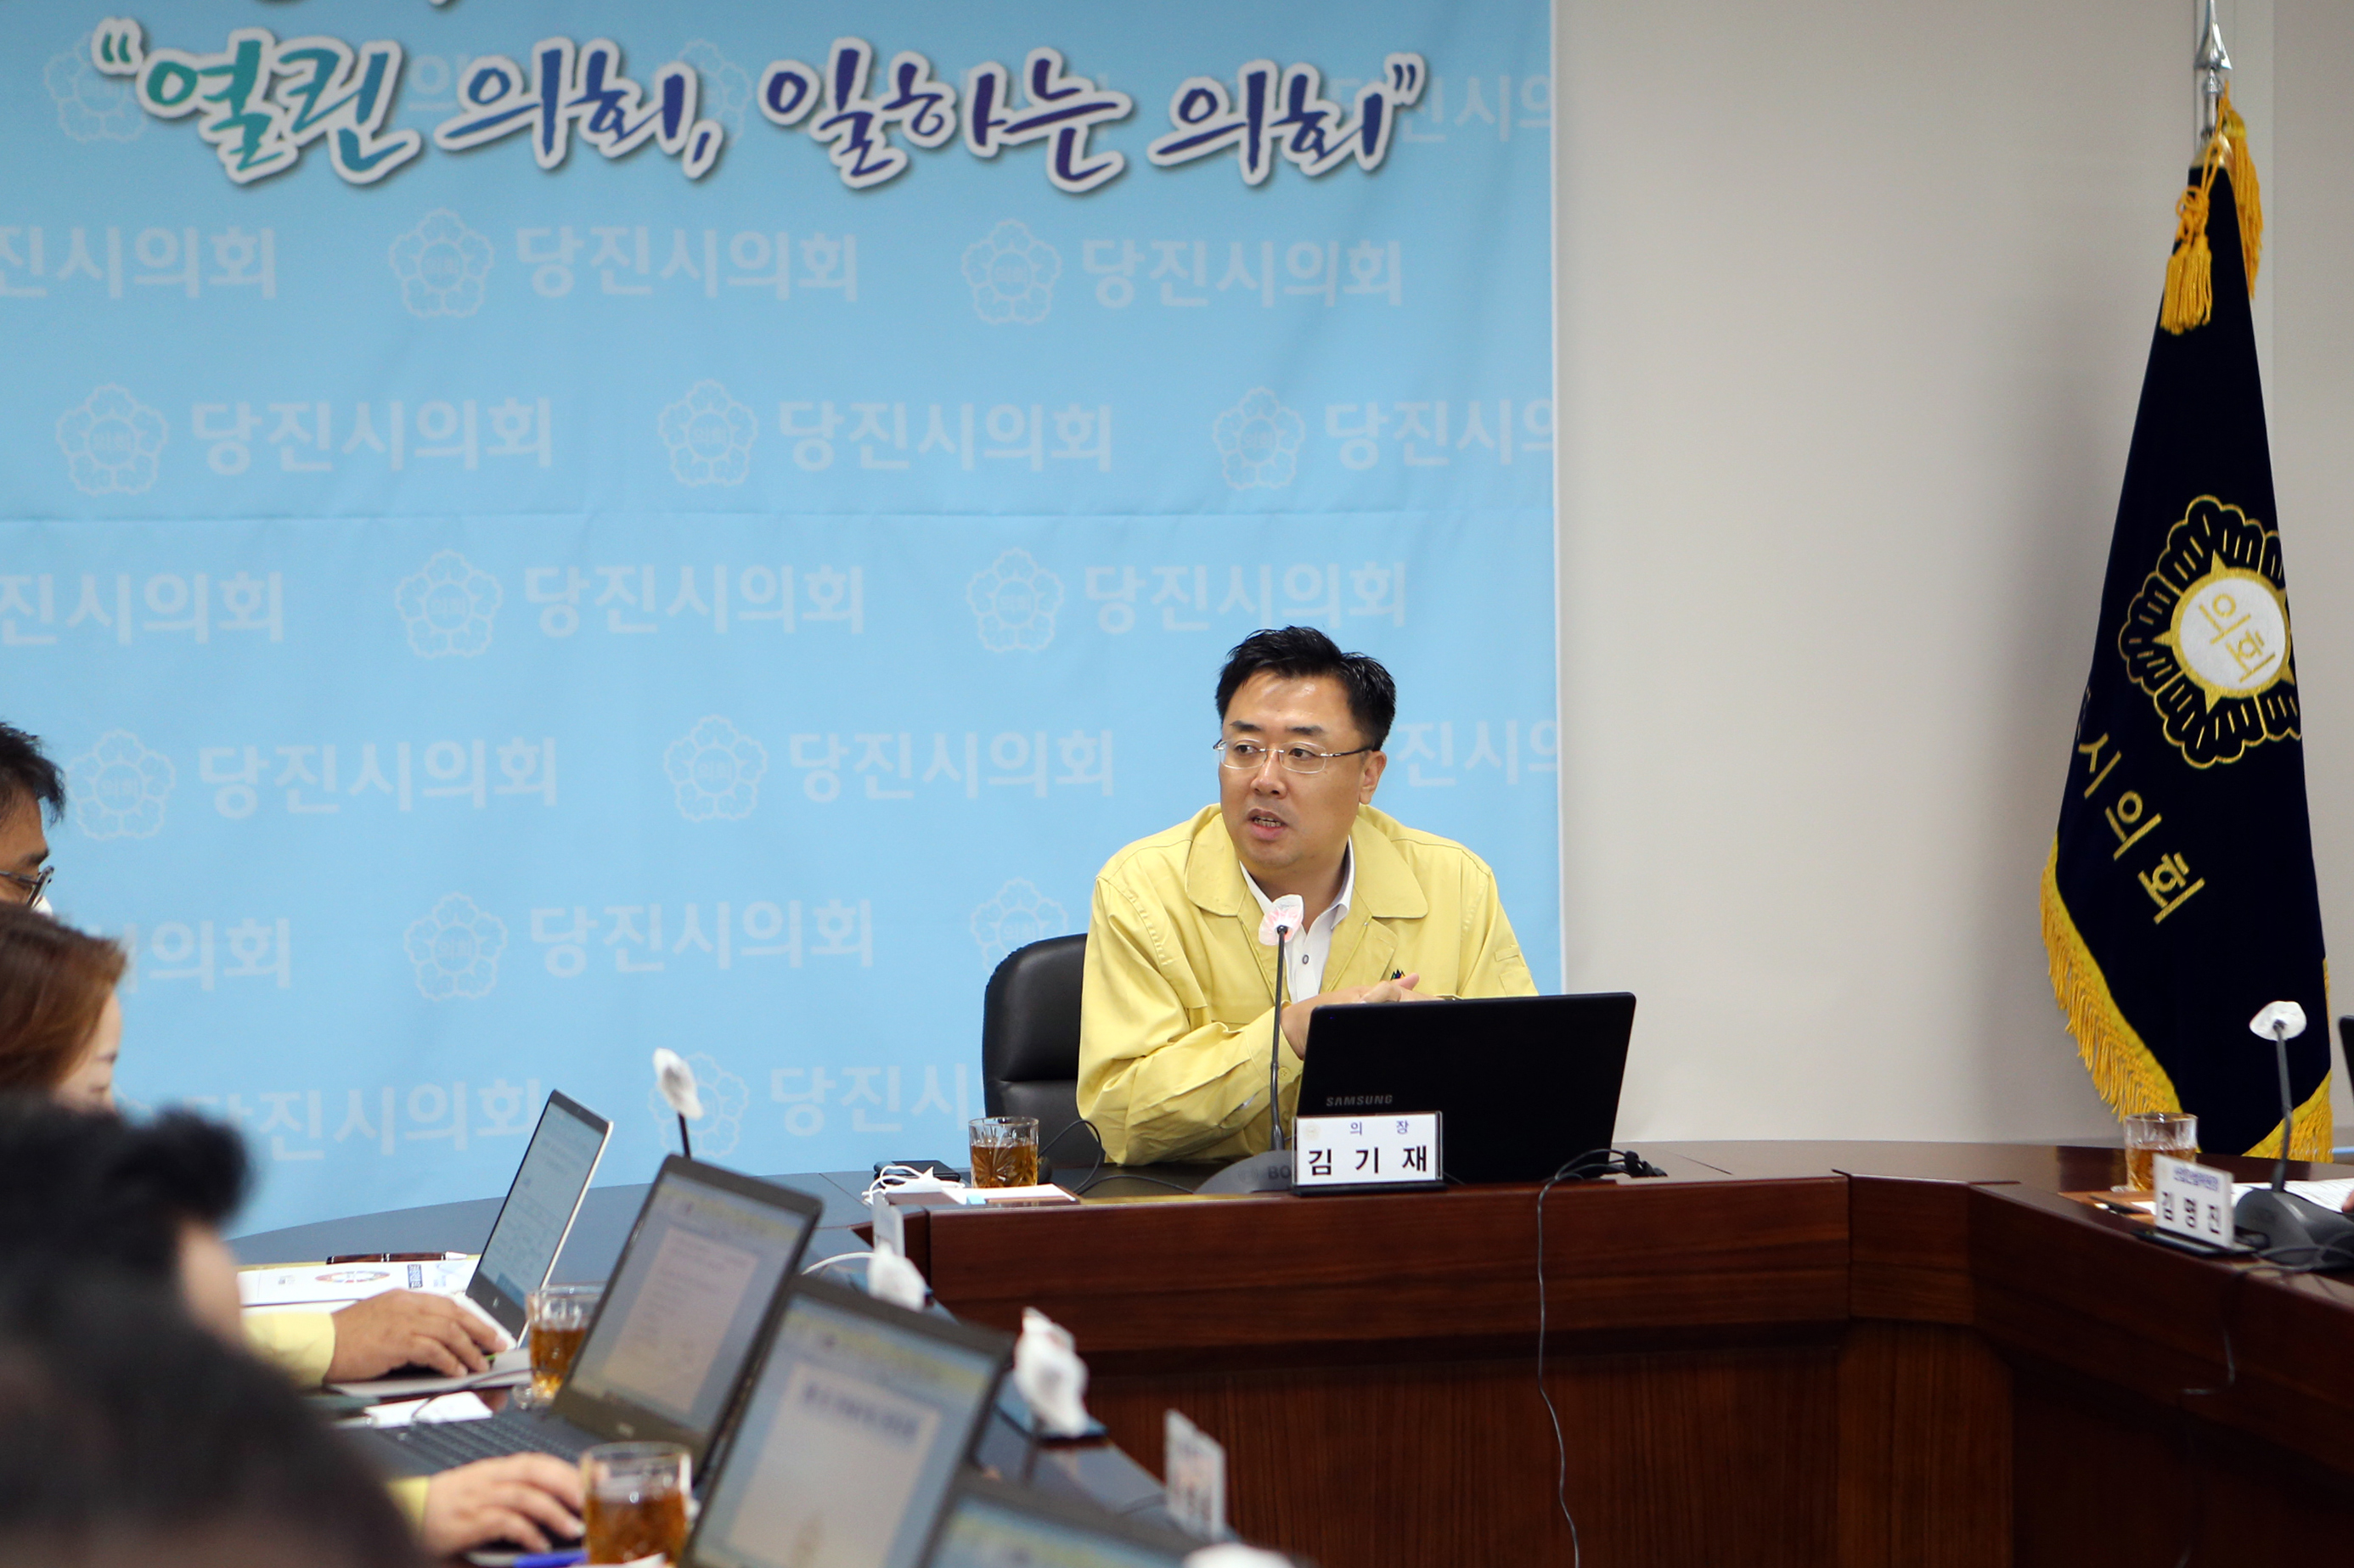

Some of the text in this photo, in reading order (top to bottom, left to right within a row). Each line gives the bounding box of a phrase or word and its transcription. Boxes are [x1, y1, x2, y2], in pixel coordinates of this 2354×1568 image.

[760, 40, 1126, 188] 일하는
[515, 226, 859, 302] 당진시의회
[1081, 239, 1403, 309] 당진시의회
[191, 397, 553, 475] 당진시의회
[778, 401, 1112, 473] 당진시의회
[524, 564, 865, 638] 당진시의회
[1084, 561, 1406, 634] 당진시의회
[2199, 593, 2275, 683] 의회
[199, 736, 559, 819] 당진시의회
[788, 729, 1114, 804] 당진시의회
[531, 899, 874, 978] 당진시의회
[770, 1062, 985, 1137] 당진시
[1326, 1094, 1393, 1107] SAMSUNG
